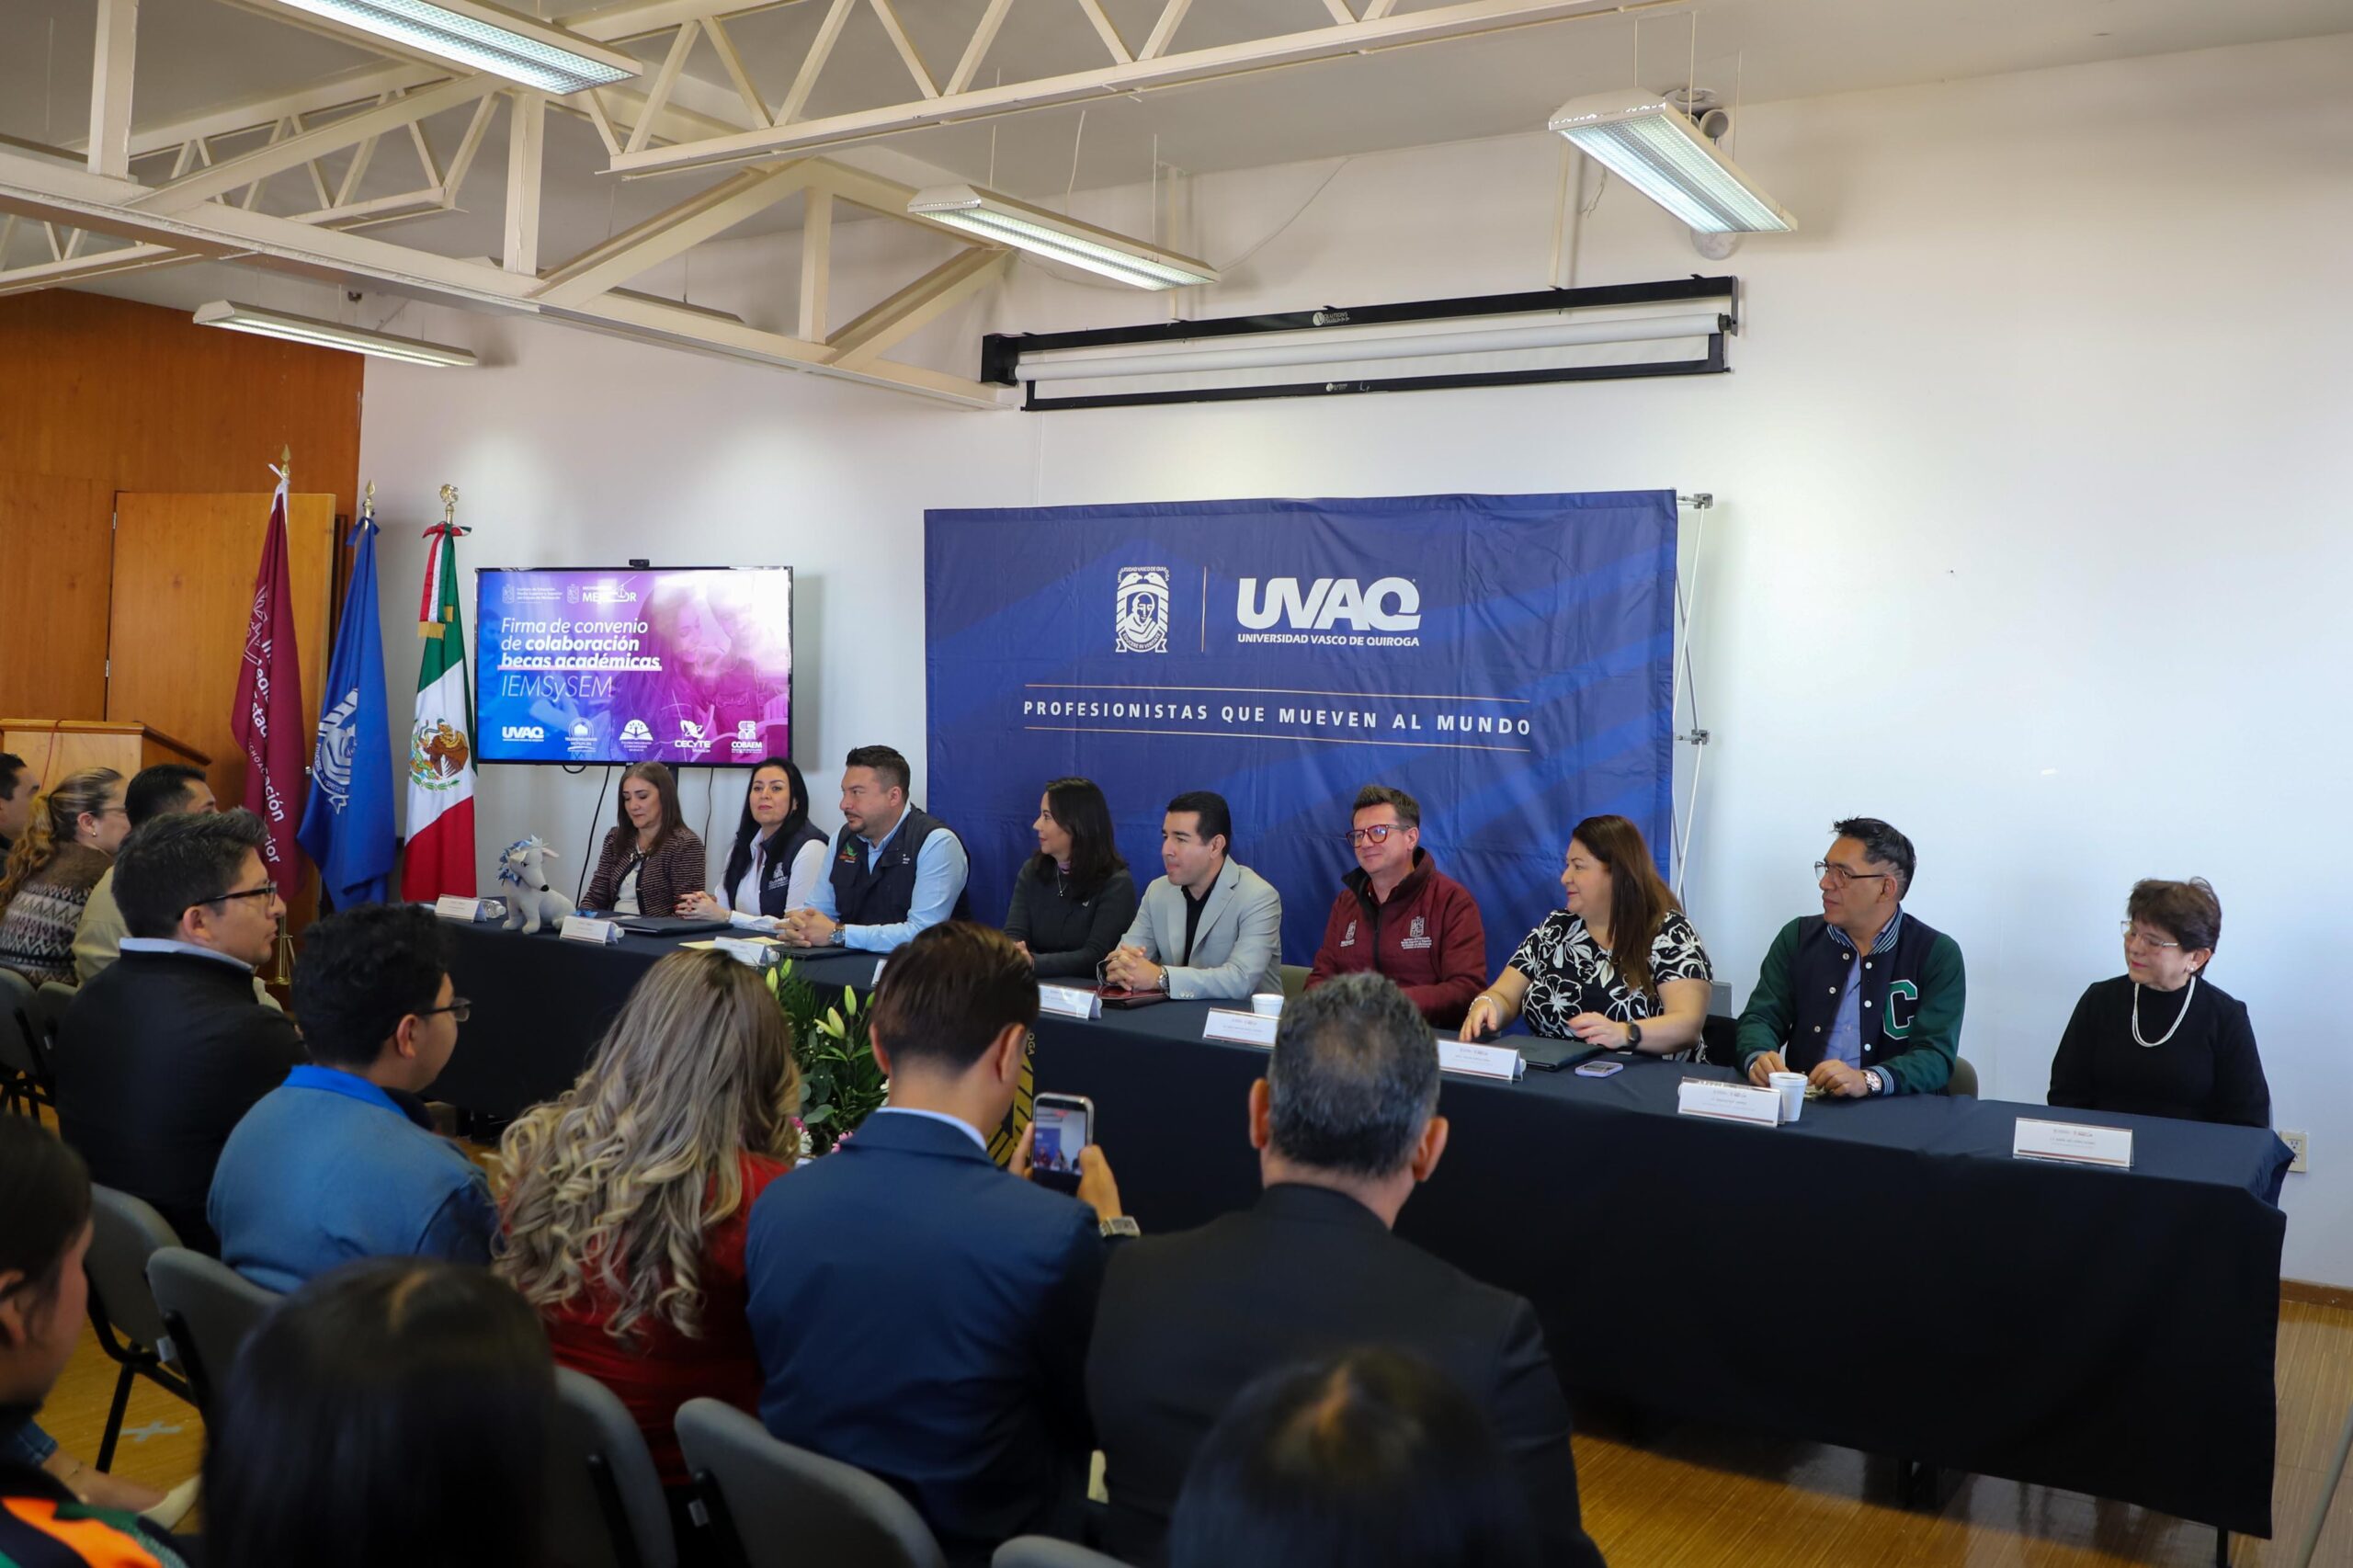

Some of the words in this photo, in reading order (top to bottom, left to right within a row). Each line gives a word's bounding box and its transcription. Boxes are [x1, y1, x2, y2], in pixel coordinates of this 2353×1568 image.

[1237, 577, 1421, 631] UVAQ
[501, 618, 546, 633] Firma
[550, 618, 571, 633] de
[574, 619, 648, 633] convenio
[501, 635, 521, 651] de
[525, 635, 640, 651] colaboración
[1237, 633, 1309, 644] UNIVERSIDAD
[1311, 634, 1347, 646] VASCO
[1349, 635, 1363, 646] DE
[1367, 637, 1419, 647] QUIROGA
[502, 653, 551, 668] becas
[555, 653, 660, 669] académicas
[502, 675, 612, 702] IEMSySEM
[1024, 701, 1207, 720] PROFESIONISTAS
[1222, 706, 1264, 723] QUE
[1279, 708, 1376, 728] MUEVEN
[1392, 714, 1421, 730] AL
[1437, 714, 1530, 735] MUNDO
[502, 726, 544, 739] UVAQ
[675, 740, 710, 748] CECYTE
[731, 741, 762, 749] COBAEM
[1882, 979, 1918, 1040] C
